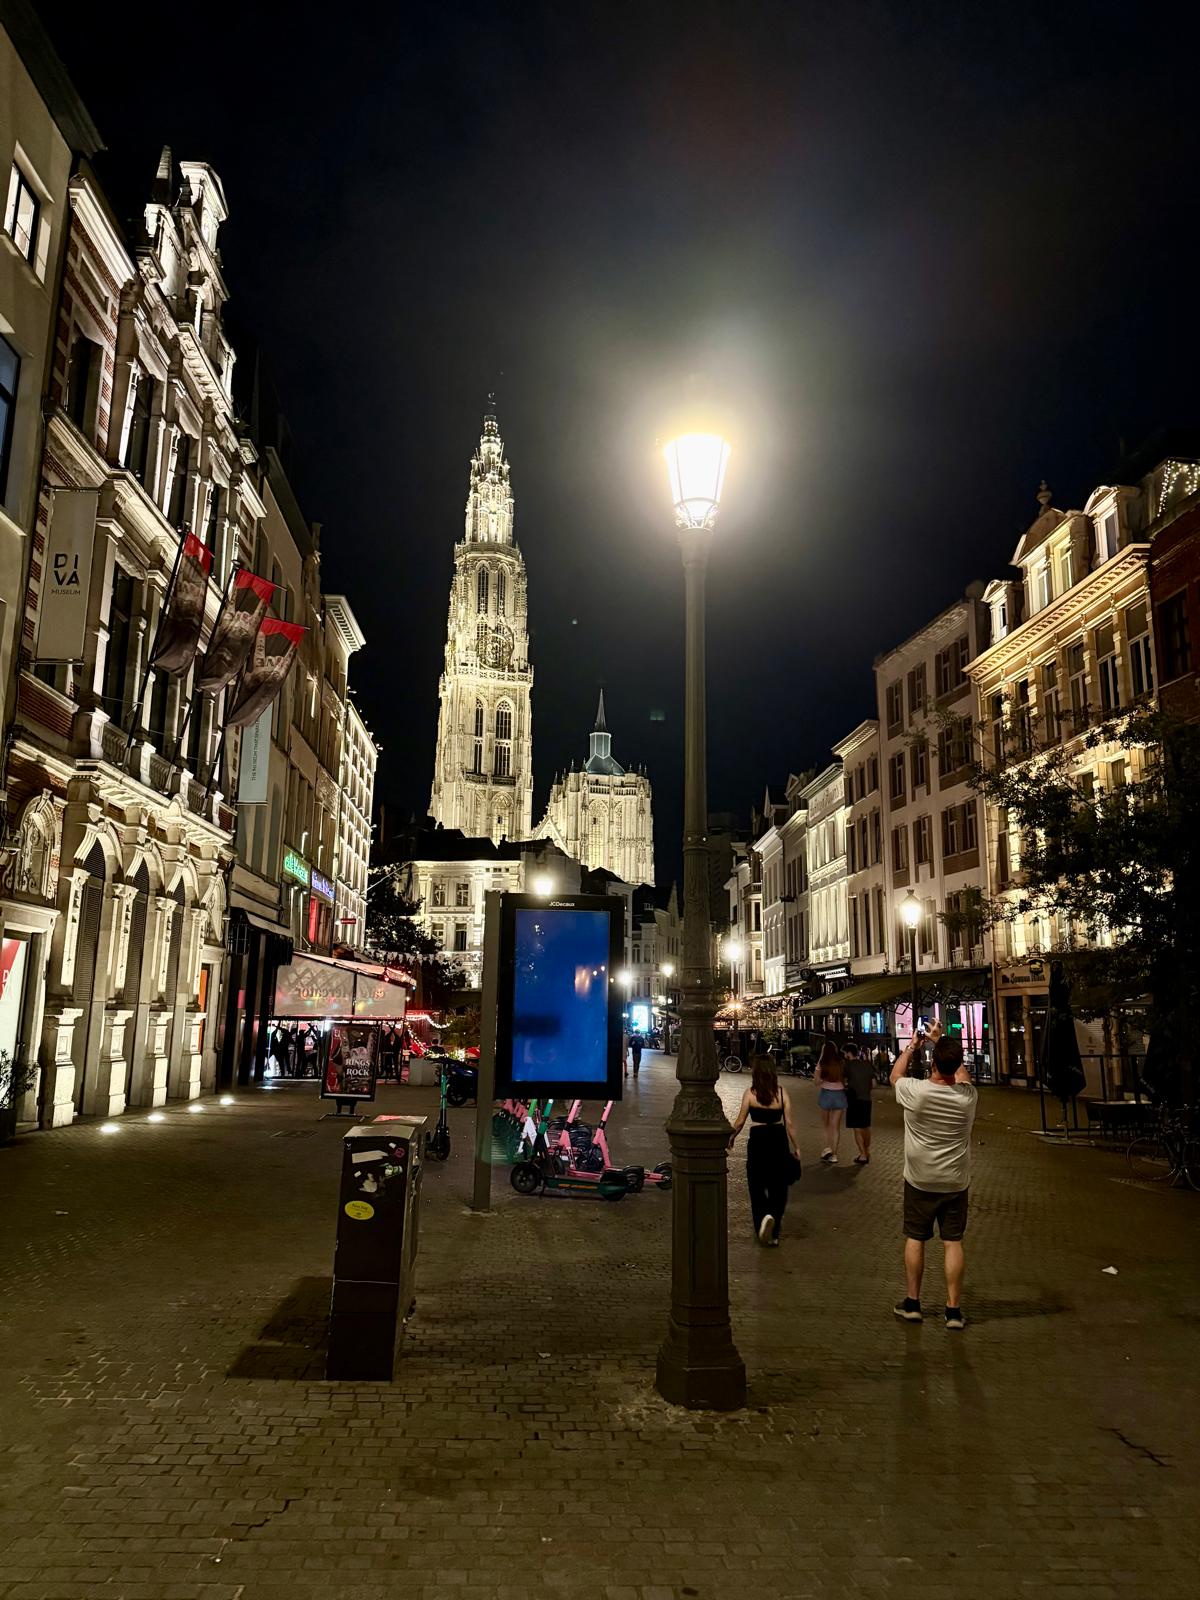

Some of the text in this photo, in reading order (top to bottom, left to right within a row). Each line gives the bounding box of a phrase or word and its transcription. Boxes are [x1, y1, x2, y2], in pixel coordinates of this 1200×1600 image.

[53, 553, 79, 569] DI
[53, 570, 80, 586] VA
[345, 1059, 370, 1067] RINGS
[346, 1068, 370, 1077] ROCK
